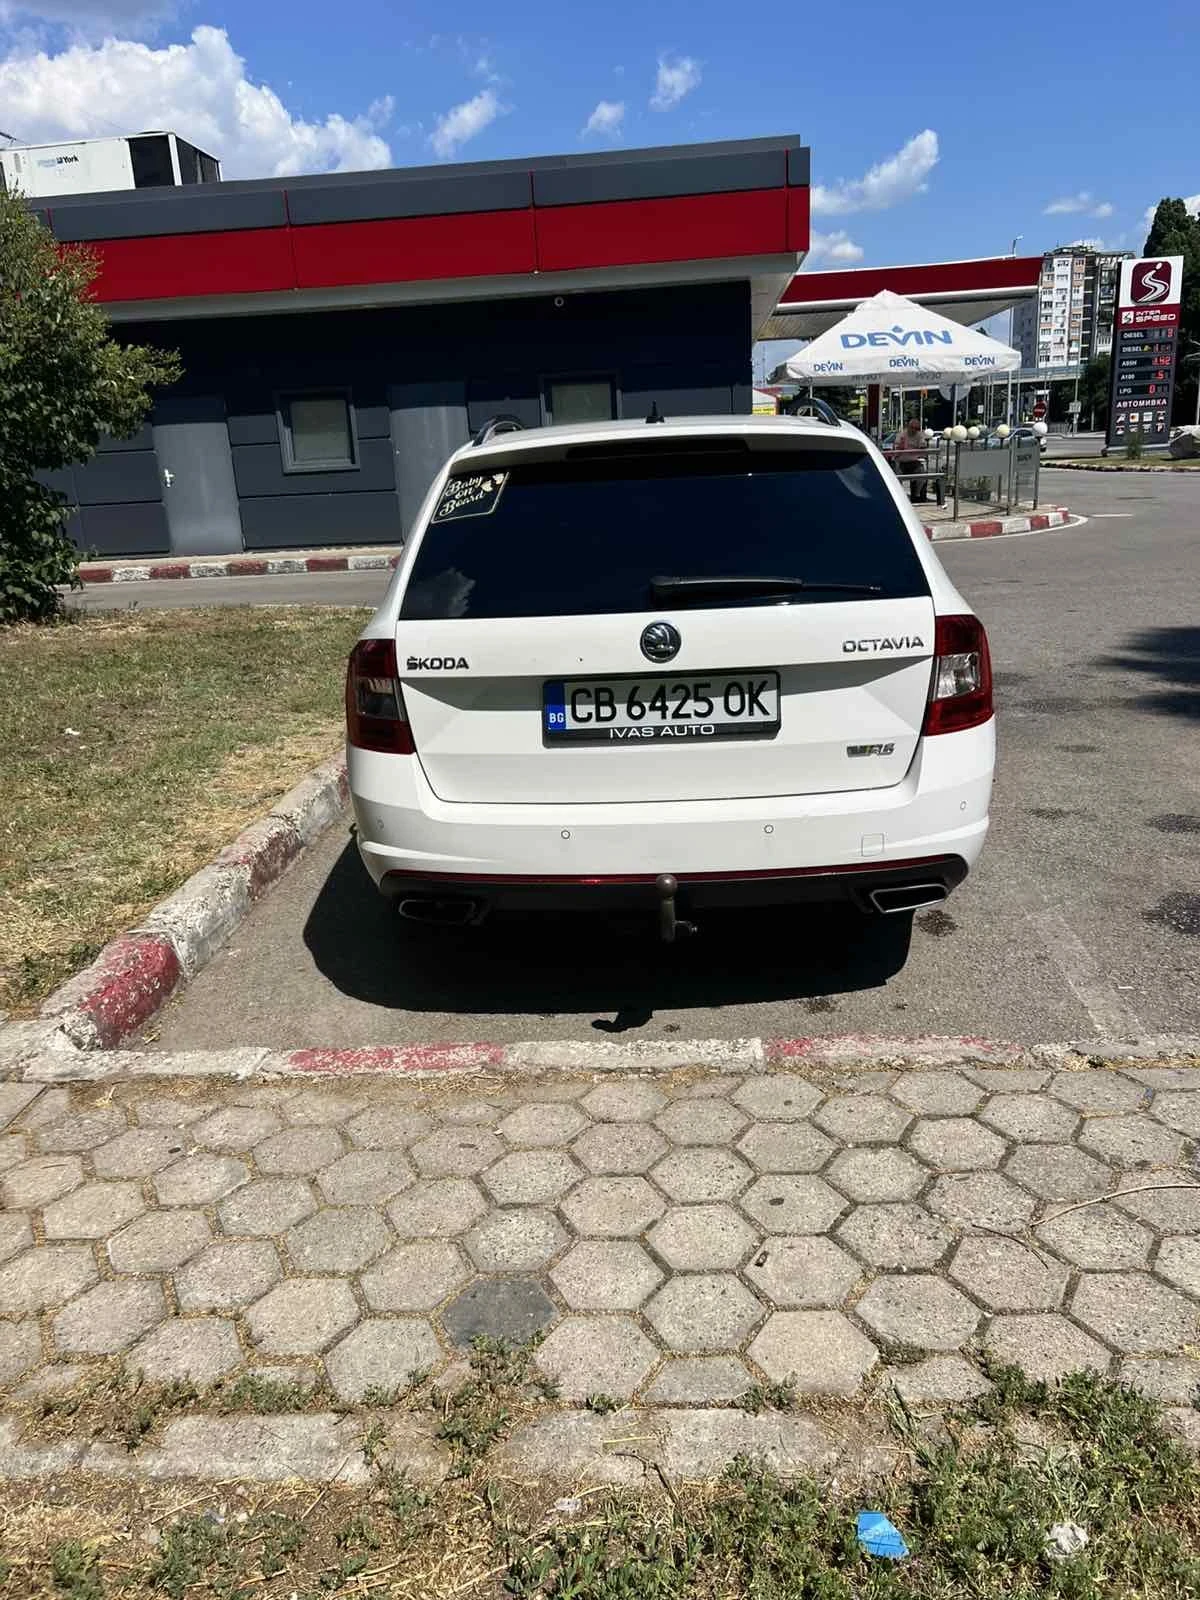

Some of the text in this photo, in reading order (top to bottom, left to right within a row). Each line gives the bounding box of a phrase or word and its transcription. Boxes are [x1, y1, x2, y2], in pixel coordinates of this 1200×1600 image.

[1136, 314, 1176, 322] SPEED
[840, 327, 952, 349] DEVIN
[1123, 331, 1144, 339] DIESEL
[814, 360, 843, 372] DEVIN
[889, 356, 919, 368] DEVIN
[964, 354, 995, 367] DEVIN
[1116, 399, 1167, 408] АВТОМИВКА
[445, 476, 483, 497] Baby
[455, 487, 474, 499] on
[440, 490, 485, 516] Board
[842, 636, 924, 652] OCTAVIA
[406, 655, 469, 671] ŠKODA
[570, 680, 770, 723] CB 6425 OK
[549, 712, 565, 723] BG
[610, 724, 715, 739] IVAS AUTO
